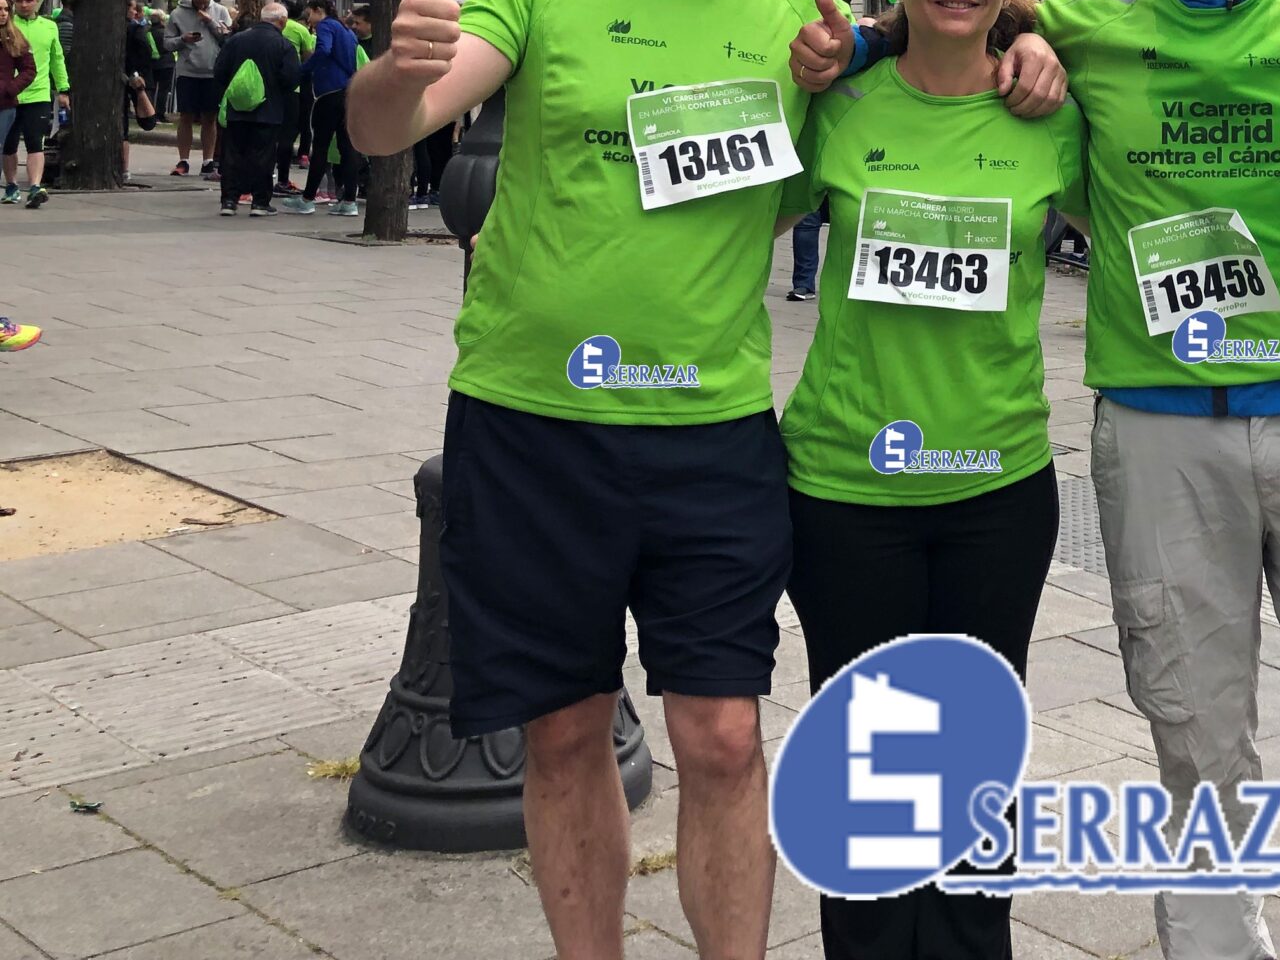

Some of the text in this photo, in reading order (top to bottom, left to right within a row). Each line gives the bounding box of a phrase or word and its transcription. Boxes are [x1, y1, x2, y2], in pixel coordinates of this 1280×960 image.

[611, 35, 667, 48] IBERDROLA
[737, 50, 768, 63] aecc
[1147, 61, 1191, 69] IBERDROLA
[630, 78, 654, 93] VI
[673, 92, 710, 103] CARRERA
[711, 87, 743, 98] MADRID
[638, 111, 650, 119] EN
[652, 105, 686, 116] MARCHA
[687, 101, 721, 110] CONTRA
[734, 92, 768, 103] CÁNCER
[1162, 102, 1273, 118] VI Carrera
[584, 129, 630, 146] con
[1161, 118, 1273, 144] Madrid
[602, 150, 635, 163] #Cor
[659, 130, 774, 186] 13461
[989, 158, 1019, 168] aecc
[1127, 148, 1196, 165] contra
[1202, 147, 1222, 164] el
[867, 163, 920, 172] IBERDROLA
[696, 175, 751, 191] #YoCorroPor
[873, 206, 886, 214] EN
[887, 208, 921, 217] MARCHA
[923, 212, 953, 222] CONTRA
[963, 214, 998, 223] CÁNCER
[911, 201, 947, 212] CARRERA
[1174, 217, 1211, 231] CARRERA
[974, 235, 998, 243] aecc
[1142, 240, 1153, 248] EN
[1154, 233, 1188, 245] MARCHA
[1189, 225, 1220, 237] CONTRA
[1009, 249, 1023, 265] er
[874, 246, 988, 294] 13463
[1159, 259, 1265, 313] 13458
[901, 291, 956, 302] #YoCorroPor
